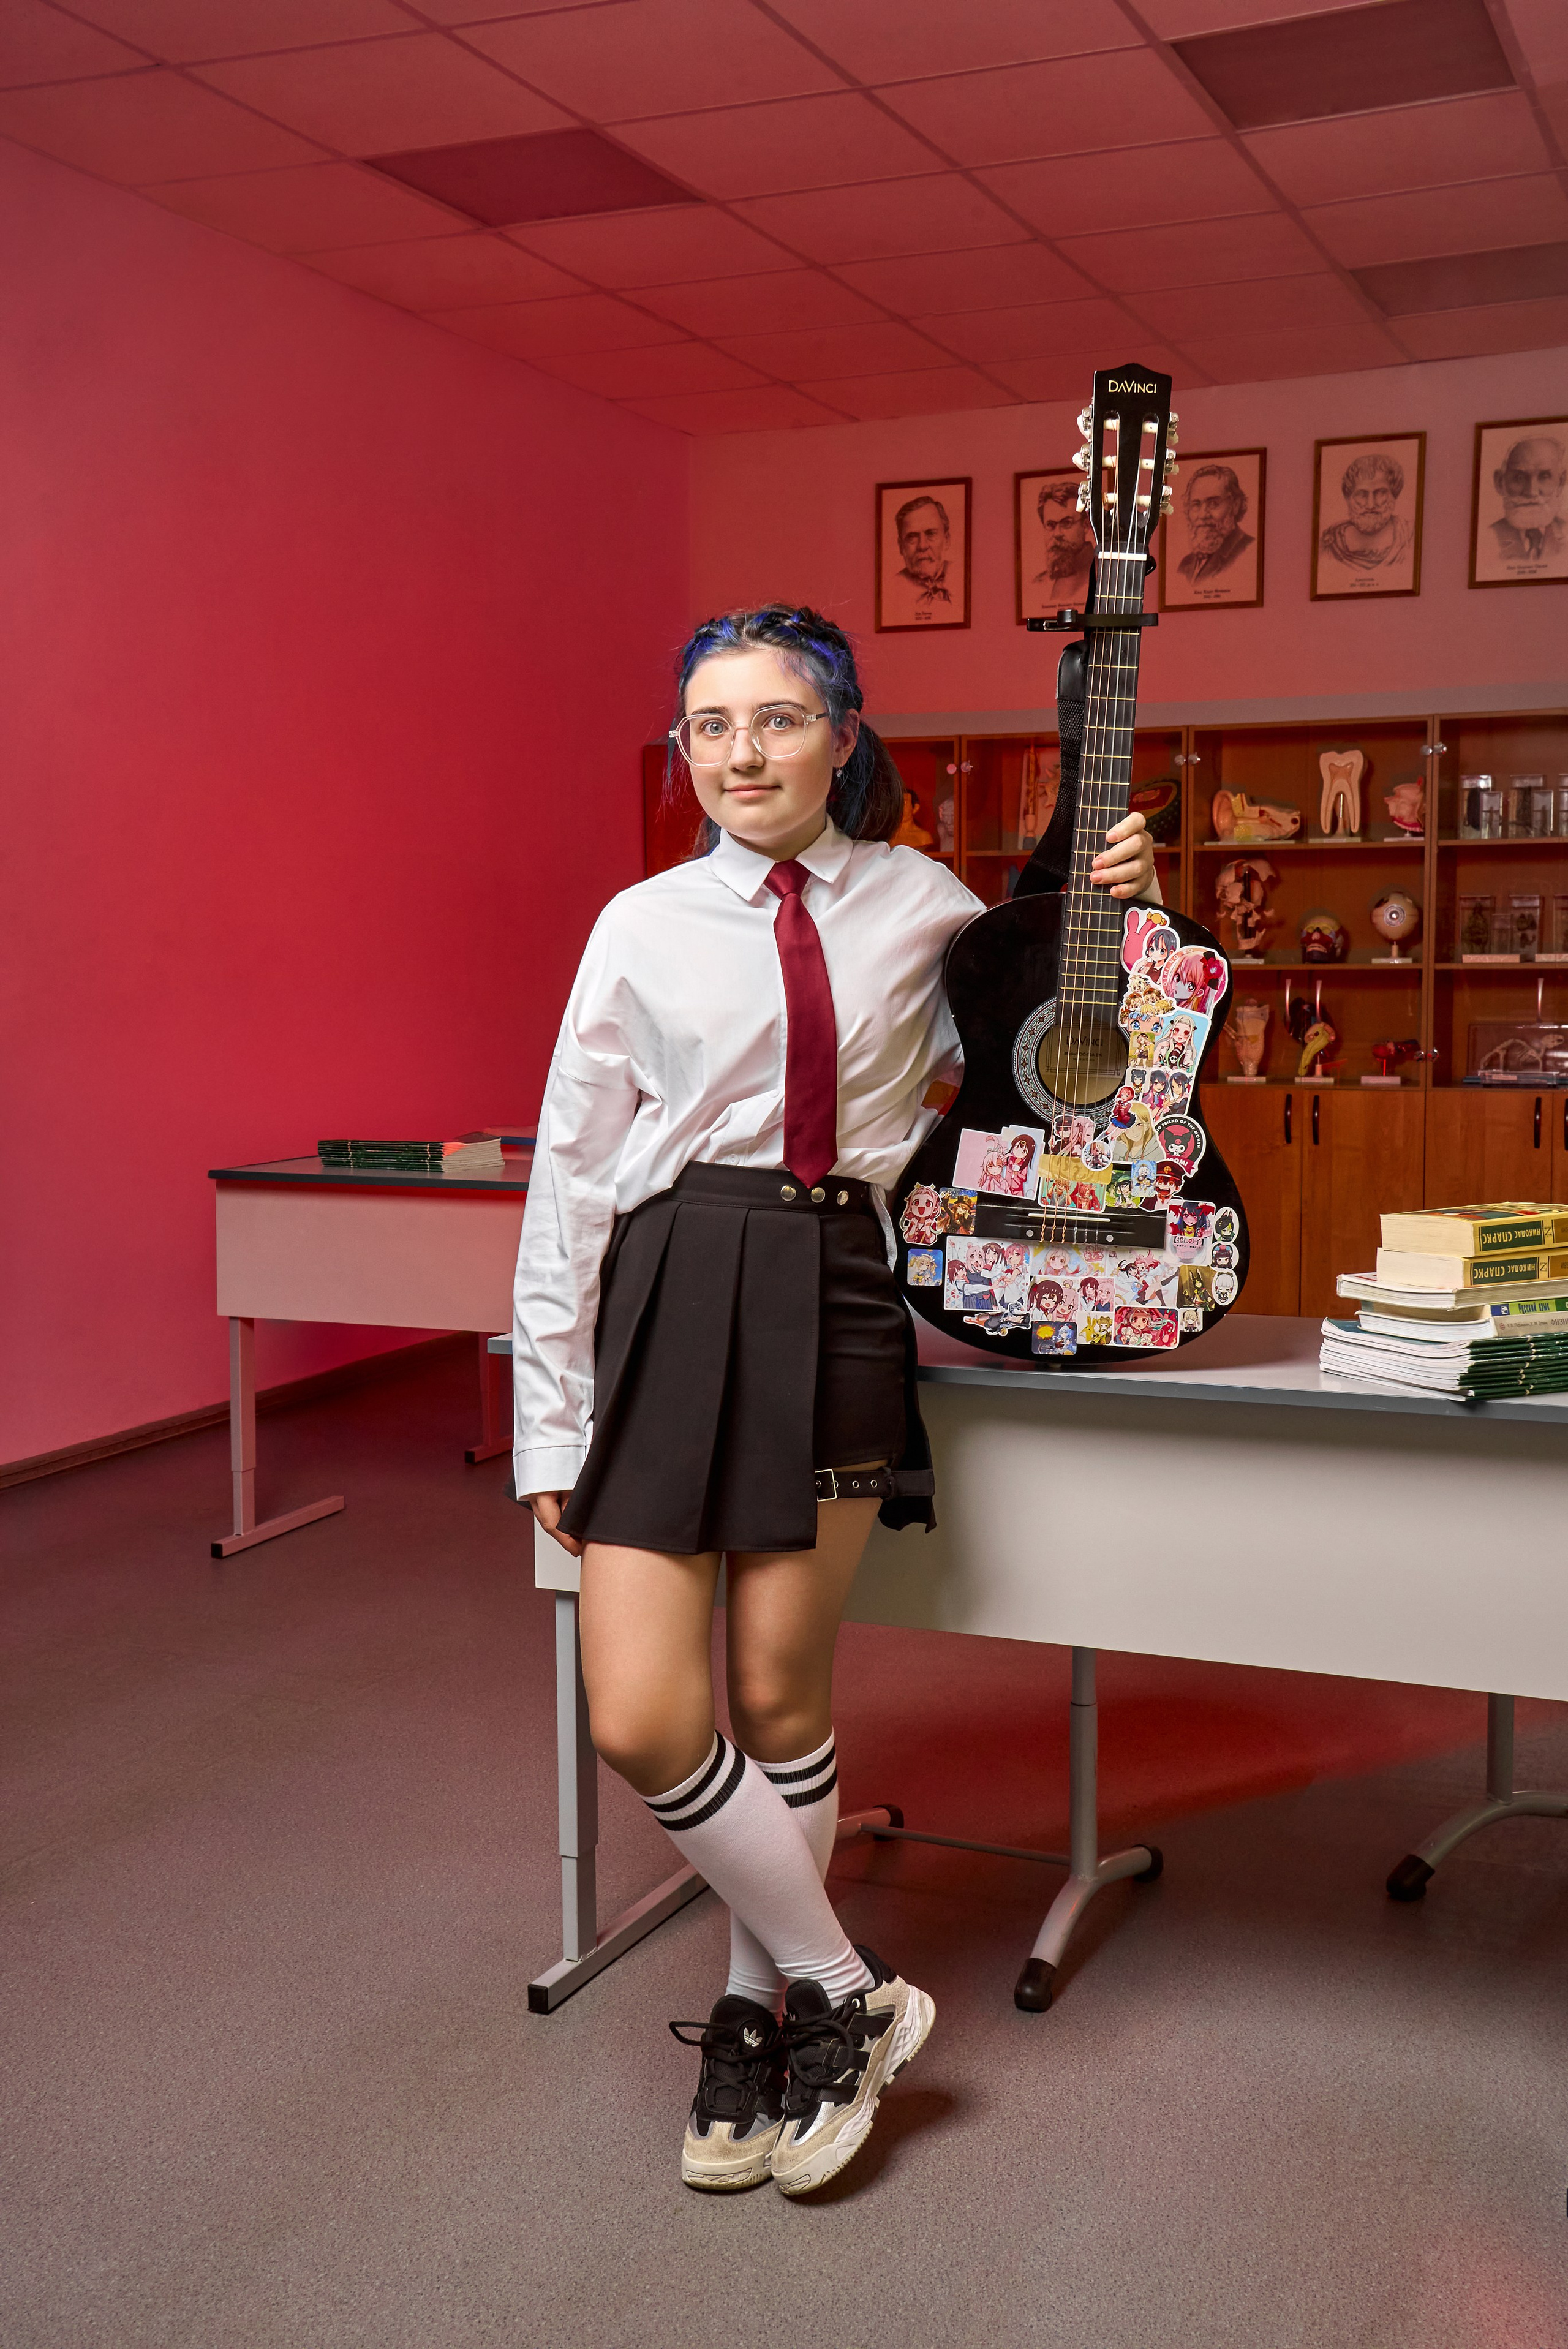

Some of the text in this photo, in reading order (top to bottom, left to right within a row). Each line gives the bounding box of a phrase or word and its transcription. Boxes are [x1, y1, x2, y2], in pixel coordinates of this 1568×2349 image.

[1169, 954, 1178, 964] NO
[1161, 1118, 1178, 1127] FRIEND
[1482, 1231, 1513, 1244] СПАРКС
[1514, 1228, 1541, 1239] НИКОЛАС
[1474, 1266, 1505, 1279] СПАРКС
[1507, 1263, 1536, 1273] НИКОЛАС
[1518, 1302, 1537, 1314] Русский
